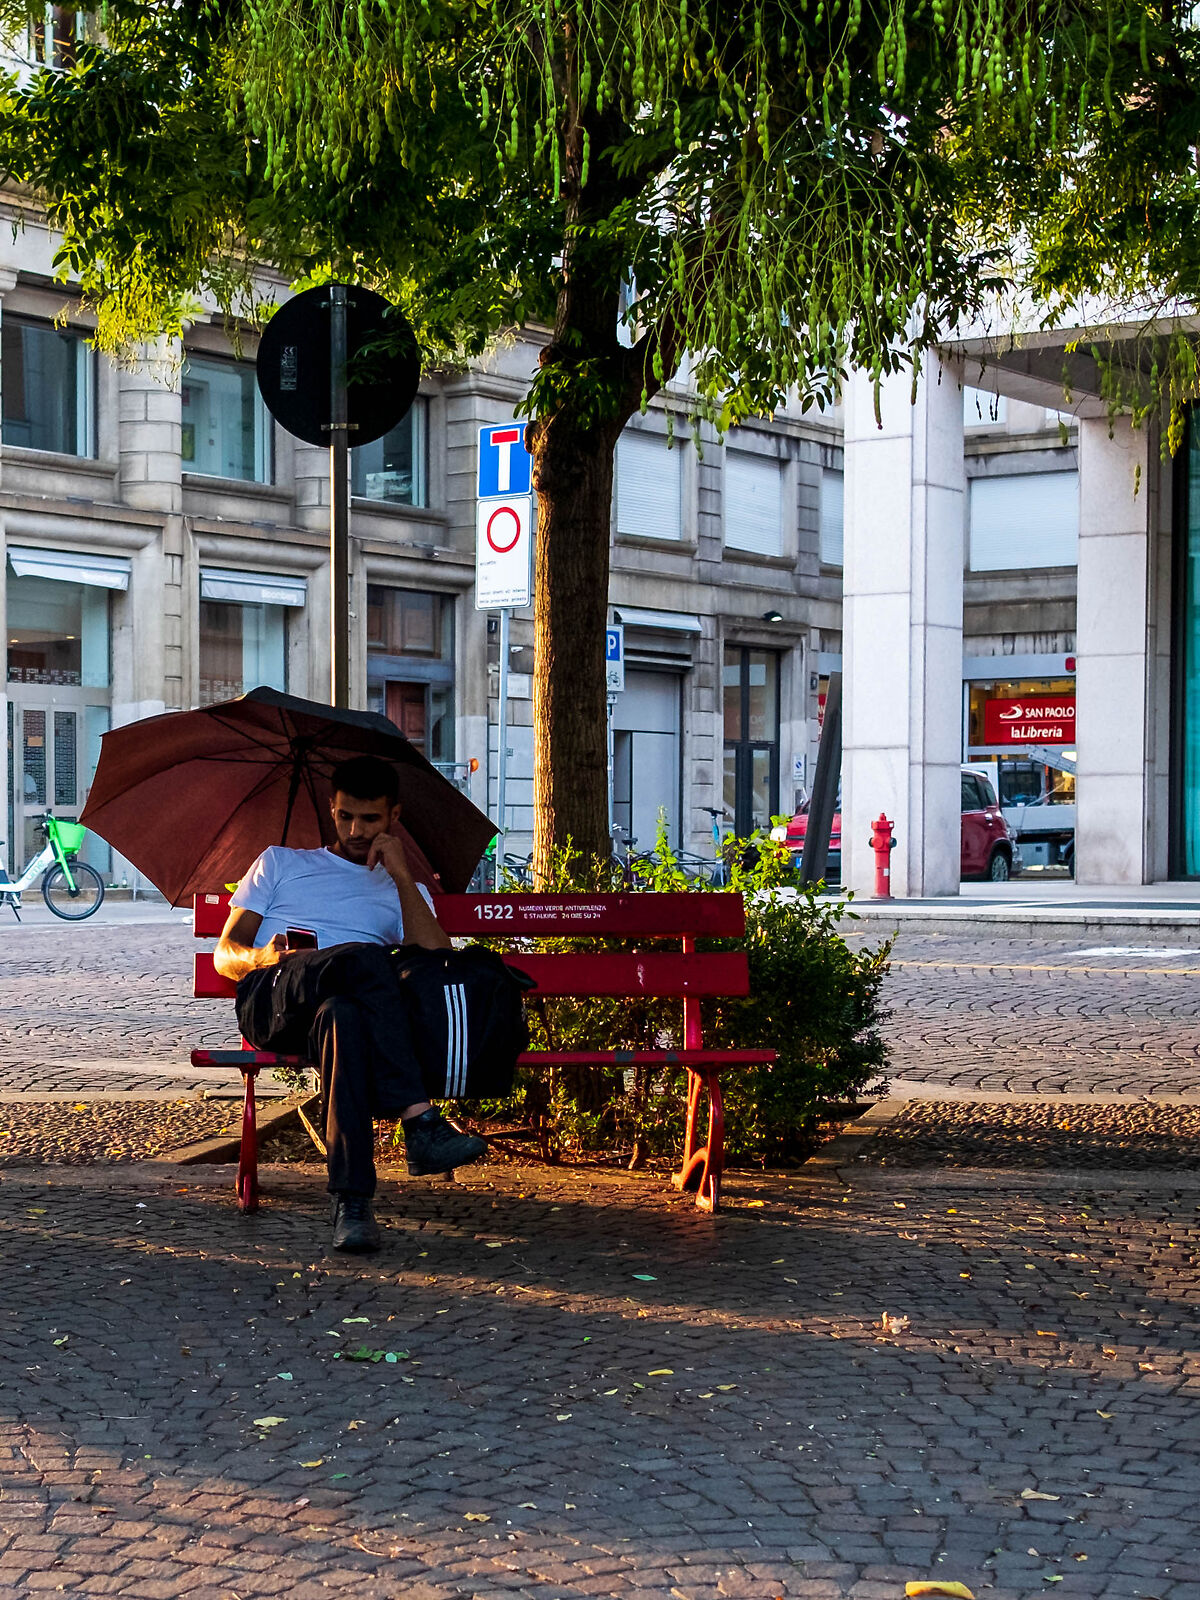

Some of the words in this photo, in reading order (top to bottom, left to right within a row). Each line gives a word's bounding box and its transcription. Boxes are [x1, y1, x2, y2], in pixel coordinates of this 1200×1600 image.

[607, 634, 617, 657] P
[1025, 707, 1043, 718] SAN
[1044, 706, 1075, 718] PAOLO
[473, 904, 514, 920] 1522
